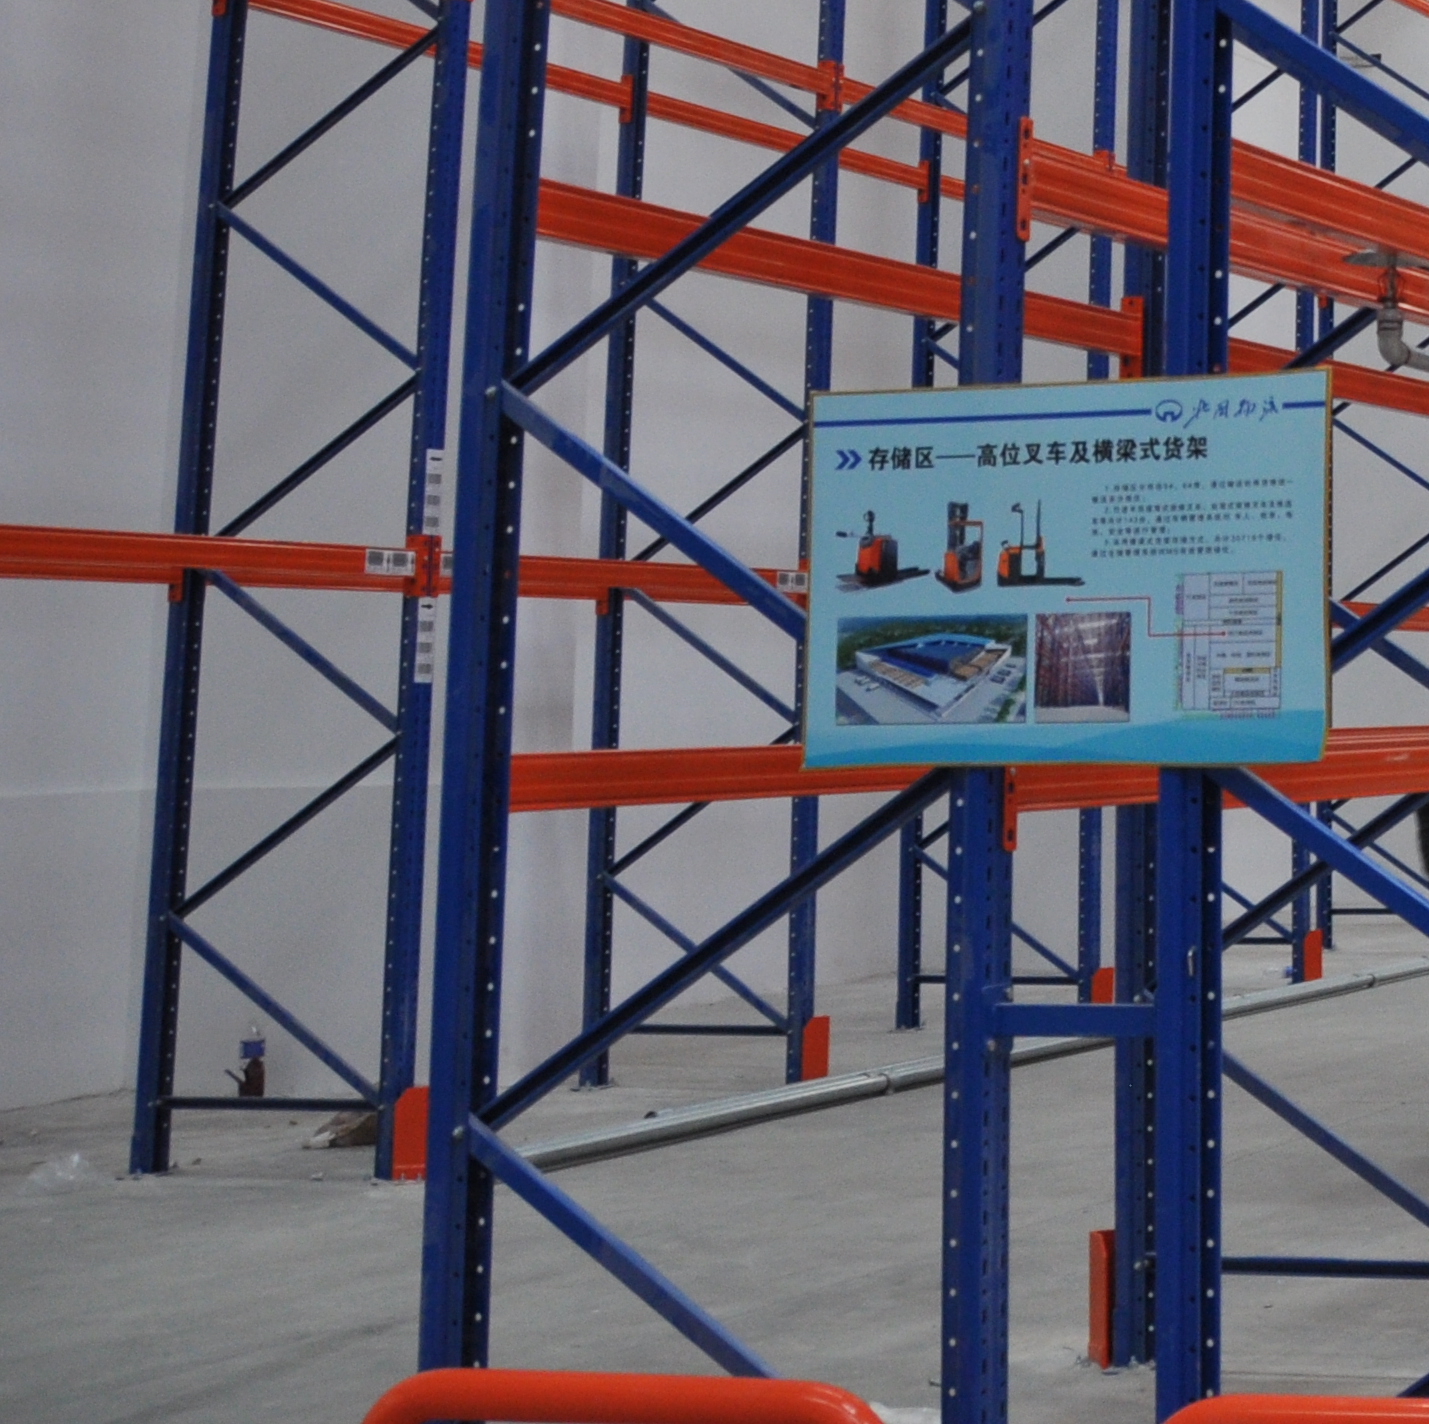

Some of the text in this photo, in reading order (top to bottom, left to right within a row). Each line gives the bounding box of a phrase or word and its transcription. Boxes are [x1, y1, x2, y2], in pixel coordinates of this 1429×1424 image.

[868, 436, 1208, 471] 存储区——高位叉车及横梁式货架
